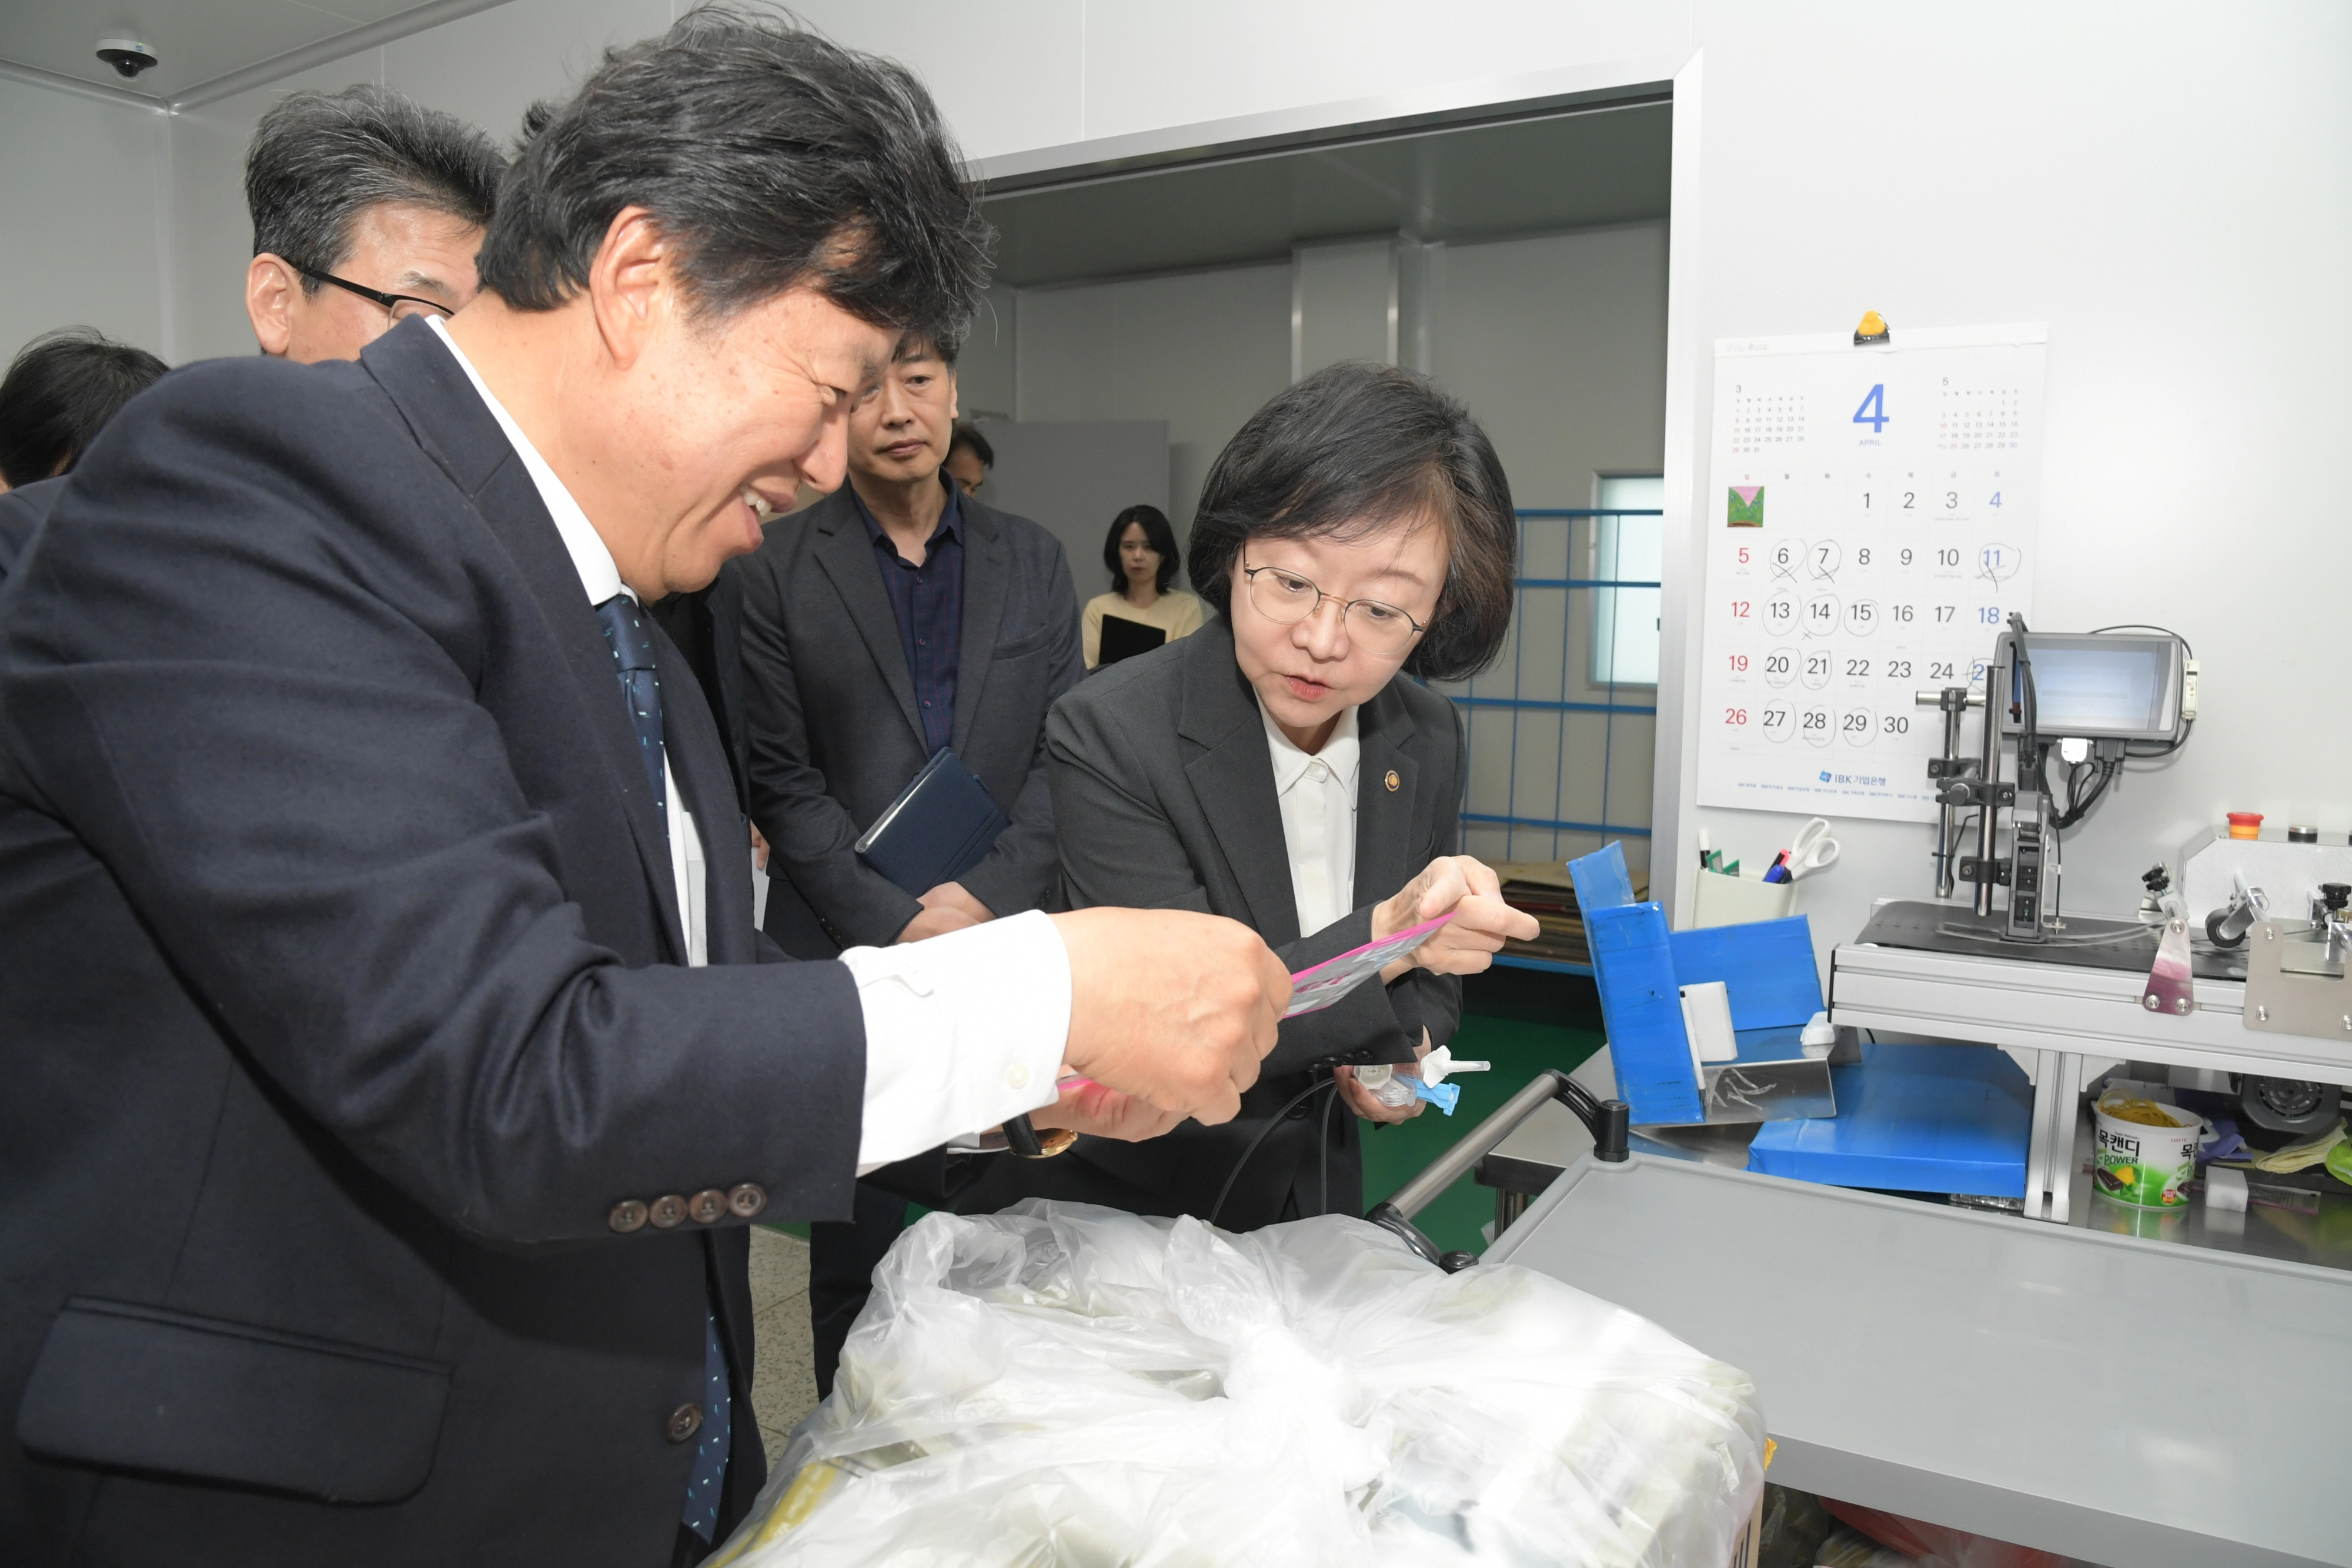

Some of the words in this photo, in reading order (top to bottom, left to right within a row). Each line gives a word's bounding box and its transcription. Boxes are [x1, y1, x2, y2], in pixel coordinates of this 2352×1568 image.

[1735, 385, 1742, 394] 3
[1942, 377, 1949, 386] 5
[1853, 384, 1889, 433] 4
[1863, 492, 1870, 509] 1
[1903, 492, 1915, 509] 2
[1946, 492, 1958, 509] 3
[1989, 491, 2002, 509] 4
[1738, 547, 1749, 564] 5
[1777, 547, 1789, 564] 6
[1818, 548, 1829, 564] 7
[1858, 548, 1870, 566] 8
[1900, 548, 1913, 566] 9
[1937, 548, 1960, 566] 10
[1983, 549, 2001, 567] 11
[1731, 601, 1750, 618] 12
[1770, 601, 1790, 619] 13
[1810, 603, 1830, 620] 14
[1850, 604, 1872, 621] 15
[1892, 604, 1913, 622] 16
[1935, 606, 1956, 623] 17
[1977, 606, 2000, 624] 18
[1728, 655, 1749, 672] 19
[1766, 656, 1789, 673] 20
[1807, 657, 1828, 674] 21
[1846, 658, 1870, 677] 22
[1887, 660, 1912, 678] 23
[1929, 662, 1955, 680] 24
[1725, 708, 1747, 726] 26
[1763, 710, 1786, 727] 27
[1803, 711, 1826, 729] 28
[1843, 713, 1867, 732] 29
[1883, 716, 1909, 734] 30
[2098, 1128, 2140, 1157] 목캔디
[2104, 1154, 2139, 1166] POWER
